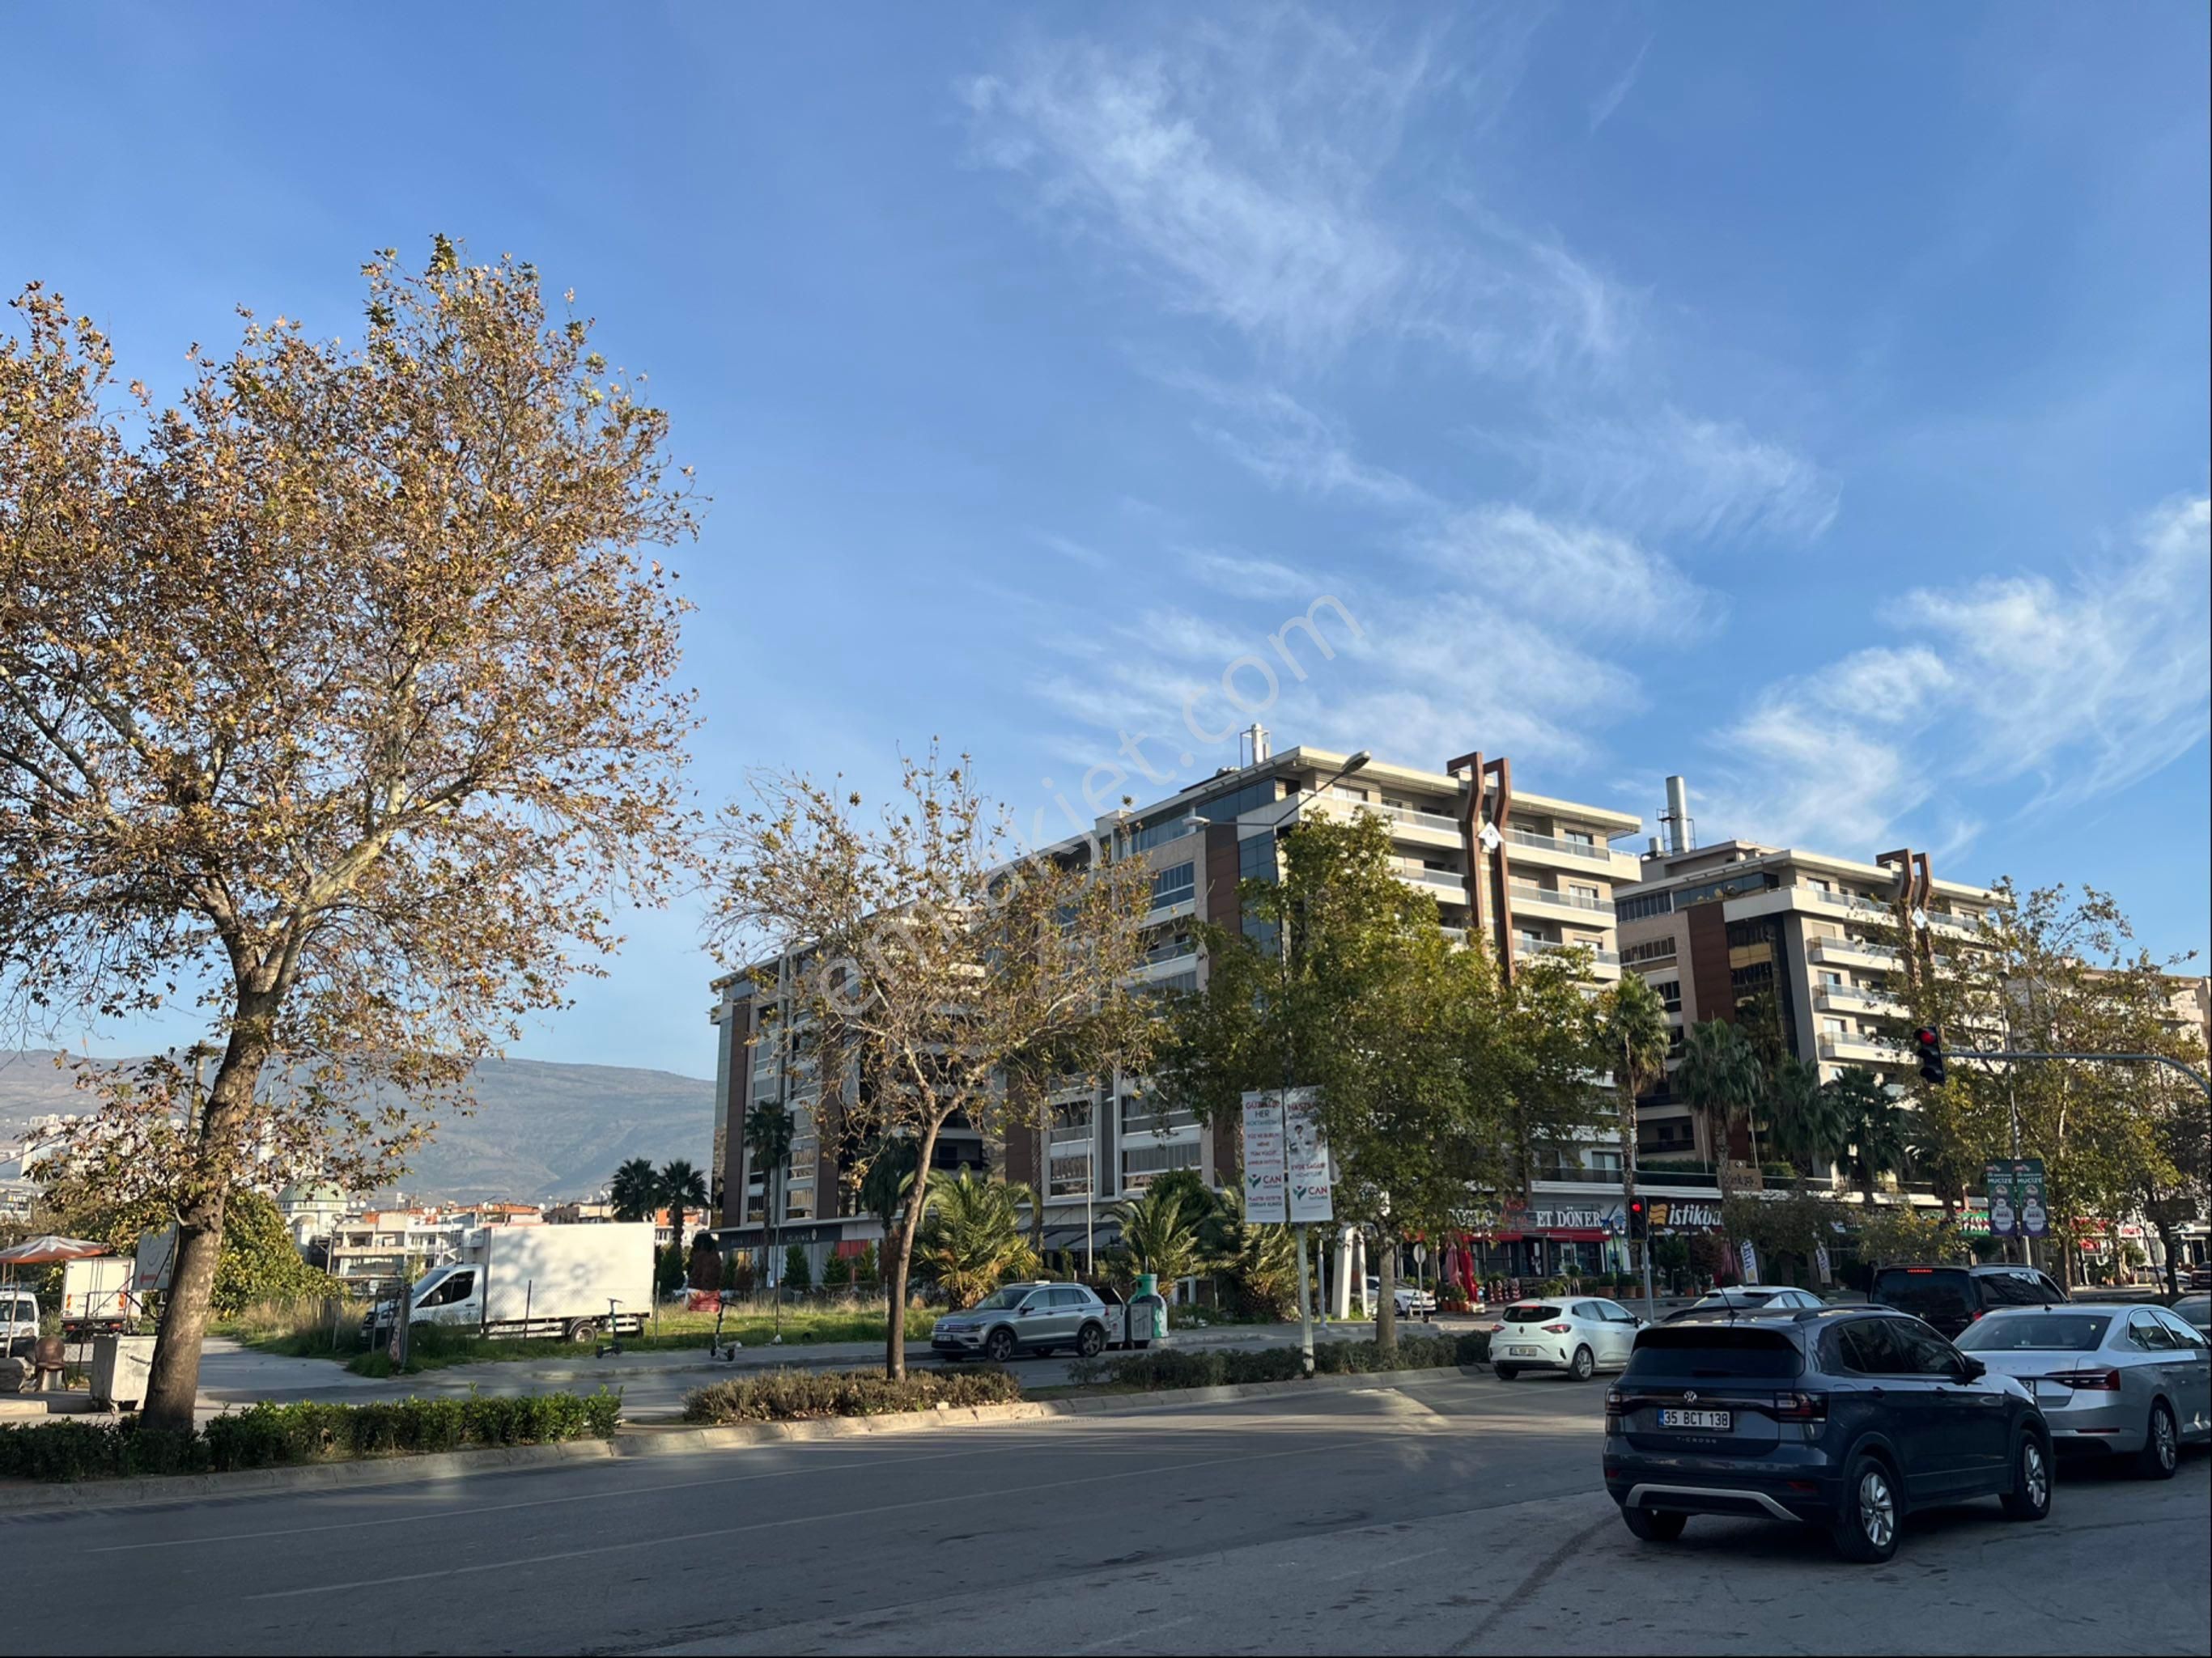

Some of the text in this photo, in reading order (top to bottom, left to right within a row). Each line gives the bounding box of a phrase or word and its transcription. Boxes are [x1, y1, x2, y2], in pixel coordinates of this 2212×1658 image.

[1255, 1109, 1270, 1118] HER
[1263, 1175, 1282, 1184] CAN
[1308, 1186, 1327, 1195] CAN
[1535, 1211, 1553, 1228] ET
[1556, 1206, 1603, 1228] DÖNER
[1664, 1410, 1728, 1427] 35 BCT 138
